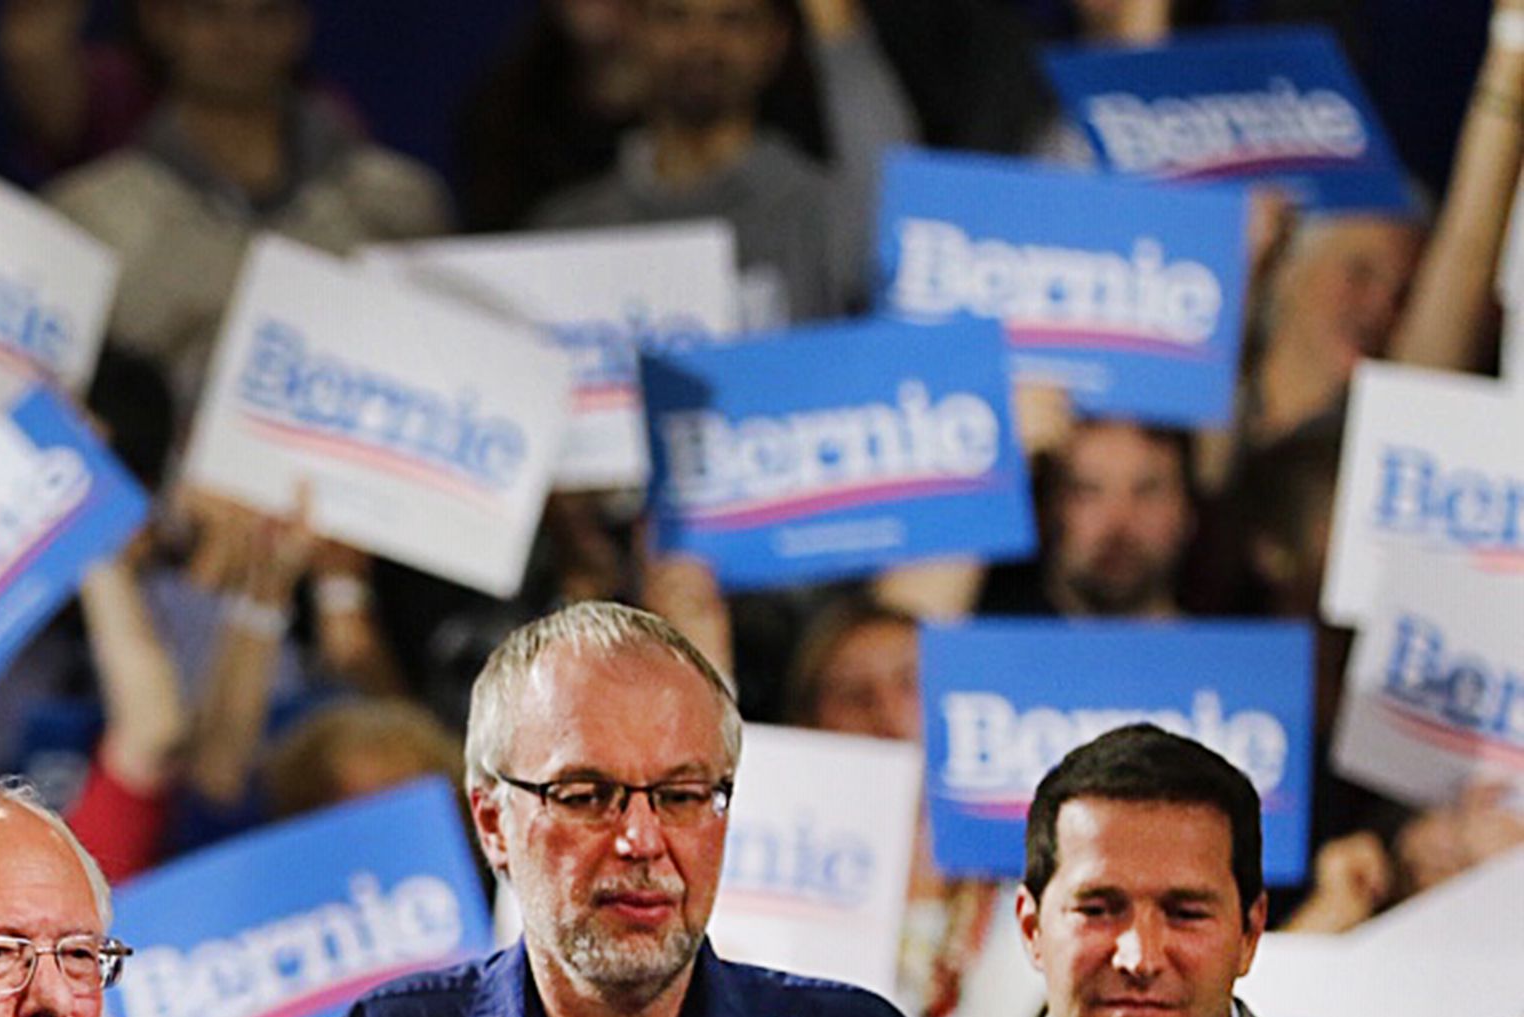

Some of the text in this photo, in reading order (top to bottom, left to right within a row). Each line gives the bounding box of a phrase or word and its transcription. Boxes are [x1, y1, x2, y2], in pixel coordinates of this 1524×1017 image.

[1086, 75, 1368, 175] Bernie
[892, 217, 1224, 345] Bernie
[239, 316, 530, 490] Bernie
[664, 378, 1000, 505] Bernie
